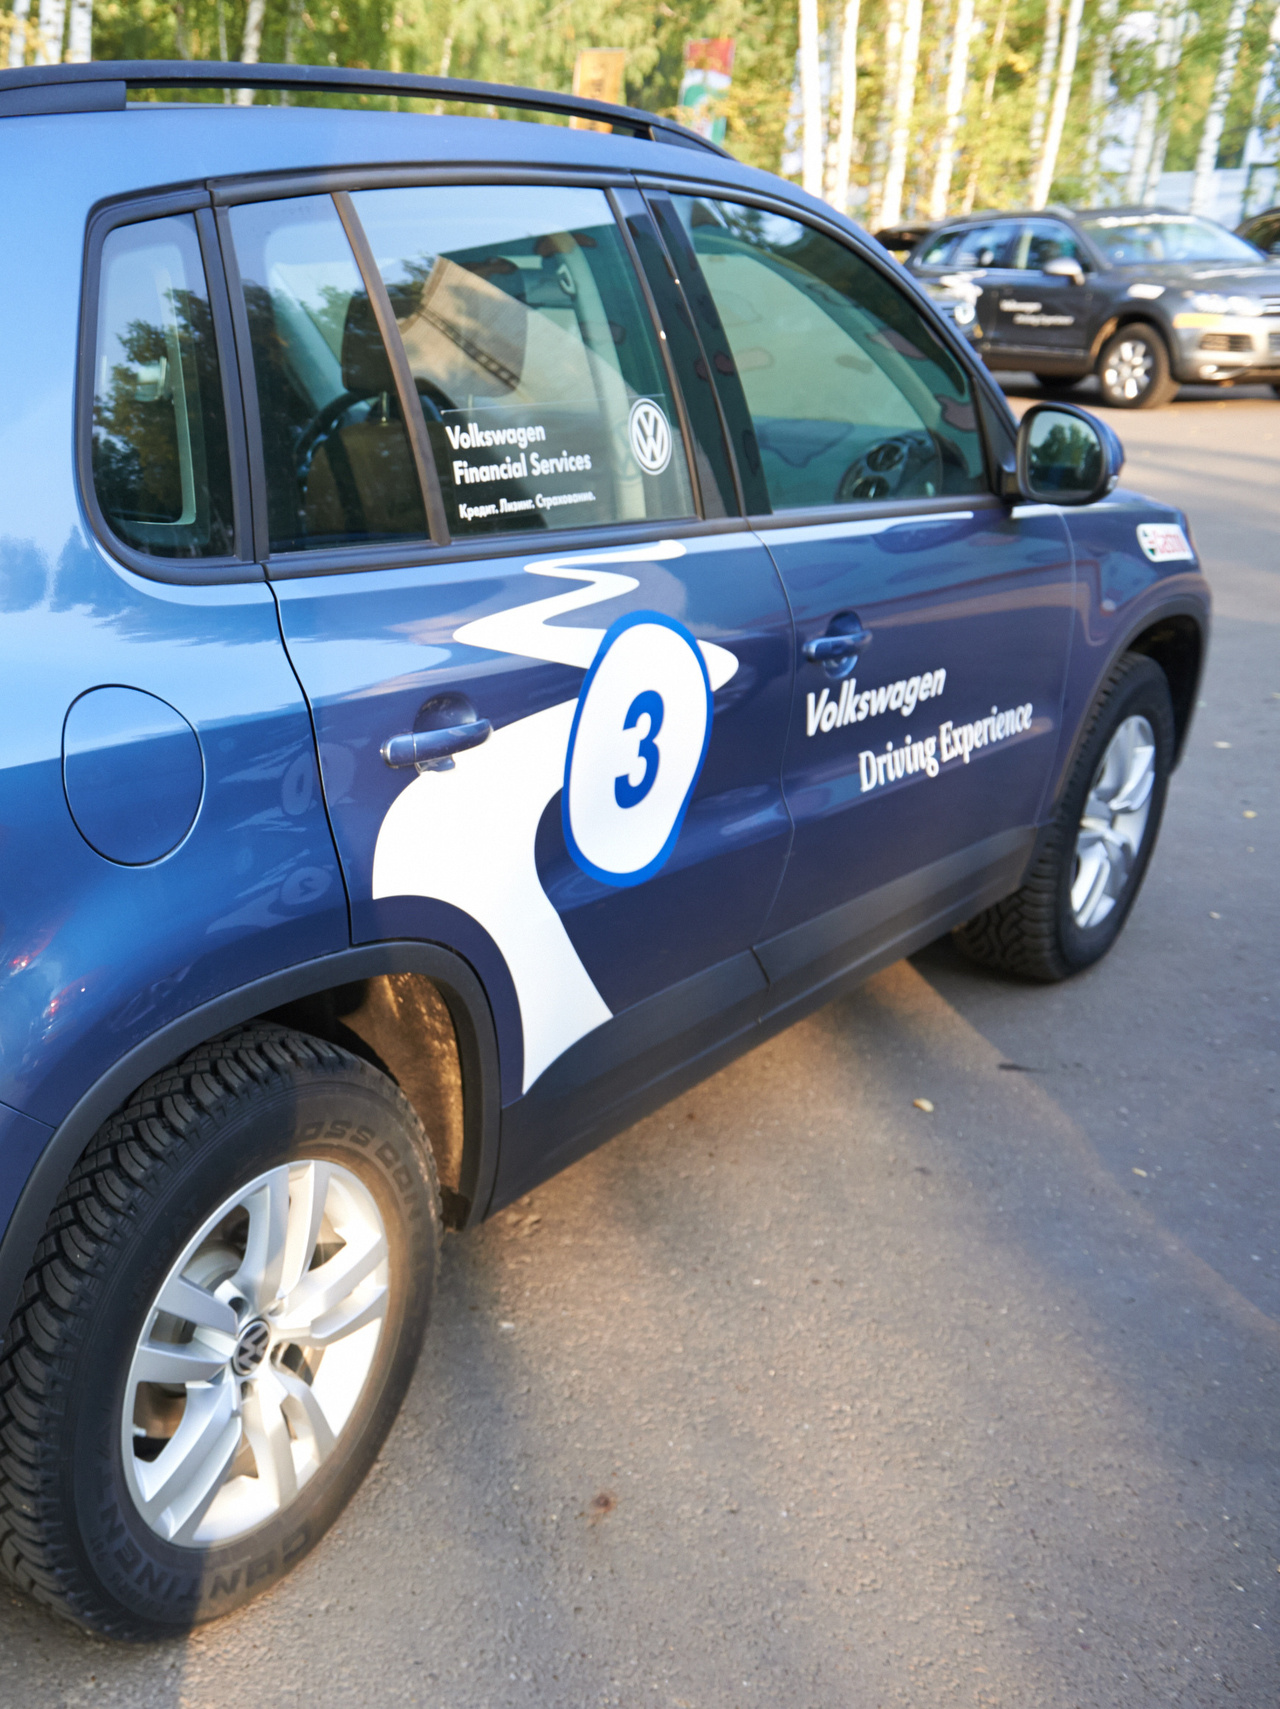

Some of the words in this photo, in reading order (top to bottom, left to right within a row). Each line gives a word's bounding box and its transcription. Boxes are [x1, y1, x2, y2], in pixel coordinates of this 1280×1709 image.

[445, 423, 546, 450] Volkswagen
[453, 453, 528, 485] Financial
[530, 450, 592, 476] Services
[806, 668, 947, 737] Volkswagen
[614, 689, 664, 809] 3
[858, 734, 939, 793] Driving
[939, 702, 1033, 764] Experience
